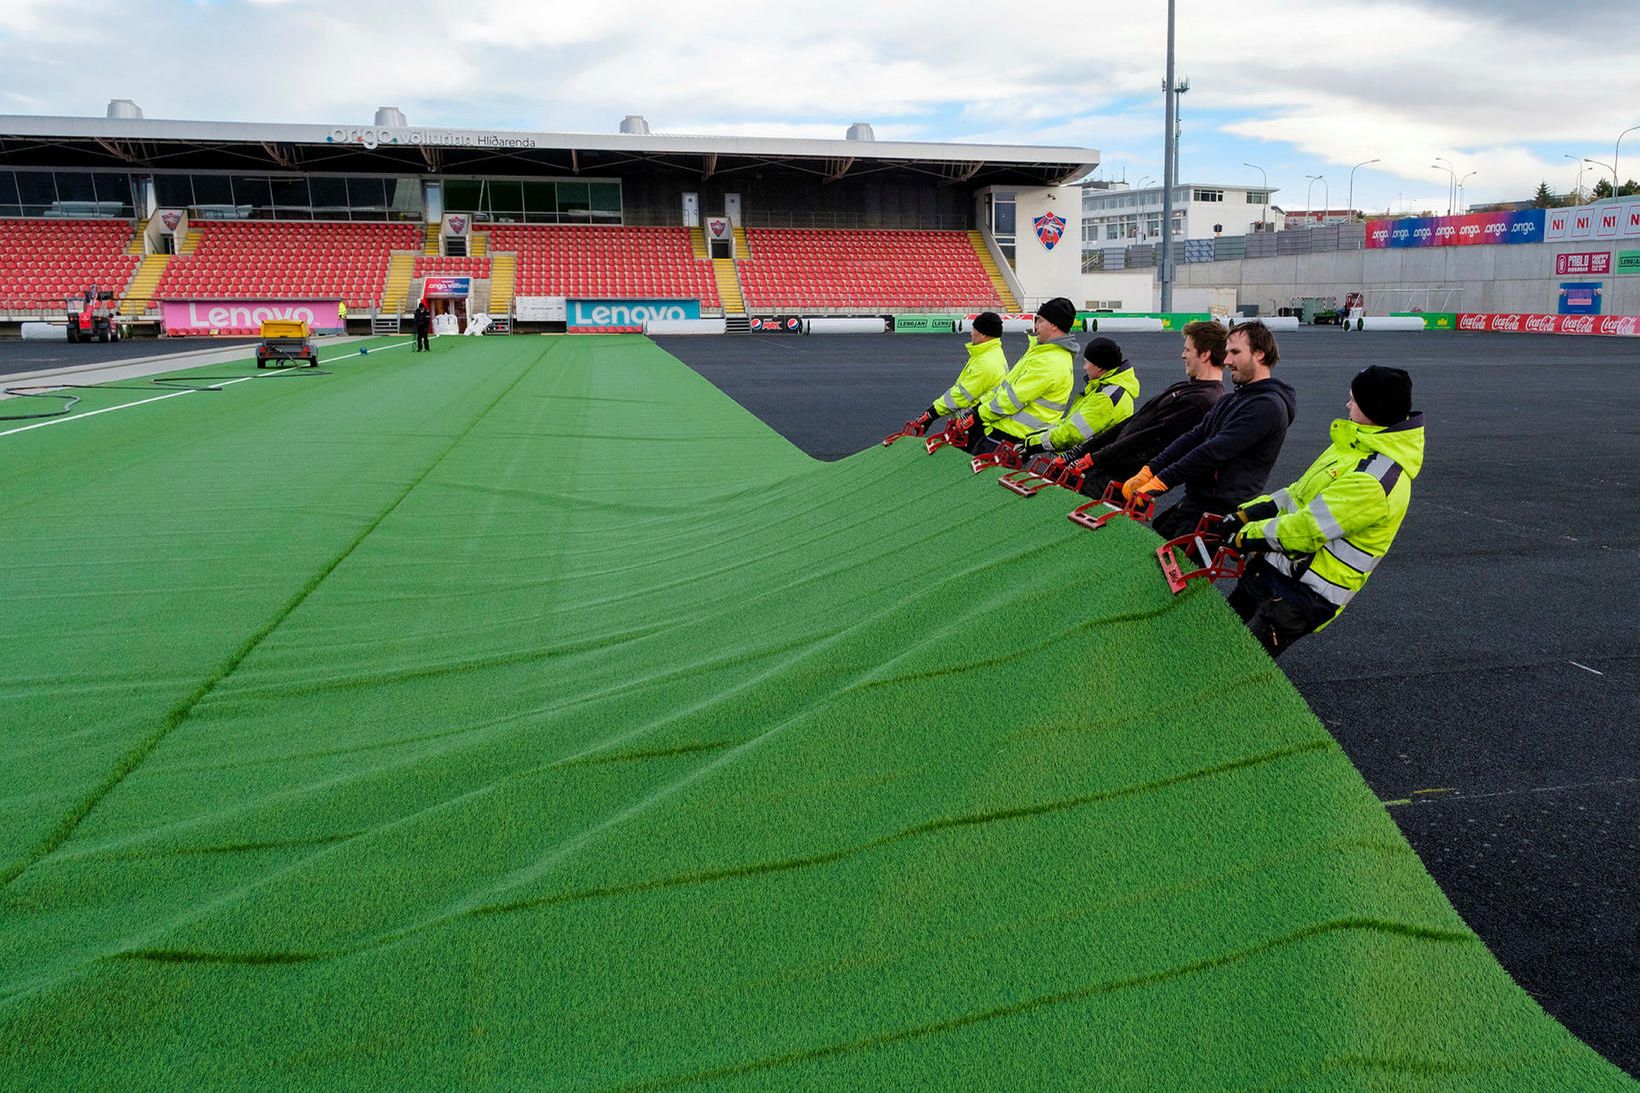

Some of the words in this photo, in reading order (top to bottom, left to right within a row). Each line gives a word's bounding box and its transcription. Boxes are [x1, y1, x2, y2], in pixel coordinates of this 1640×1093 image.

[477, 135, 536, 148] Hliðarenda
[1552, 219, 1564, 231] N1
[1577, 217, 1589, 229] N1
[1603, 216, 1616, 228] N1
[1631, 214, 1640, 226] N
[189, 303, 315, 328] Lenovo
[575, 302, 687, 325] Lenovo
